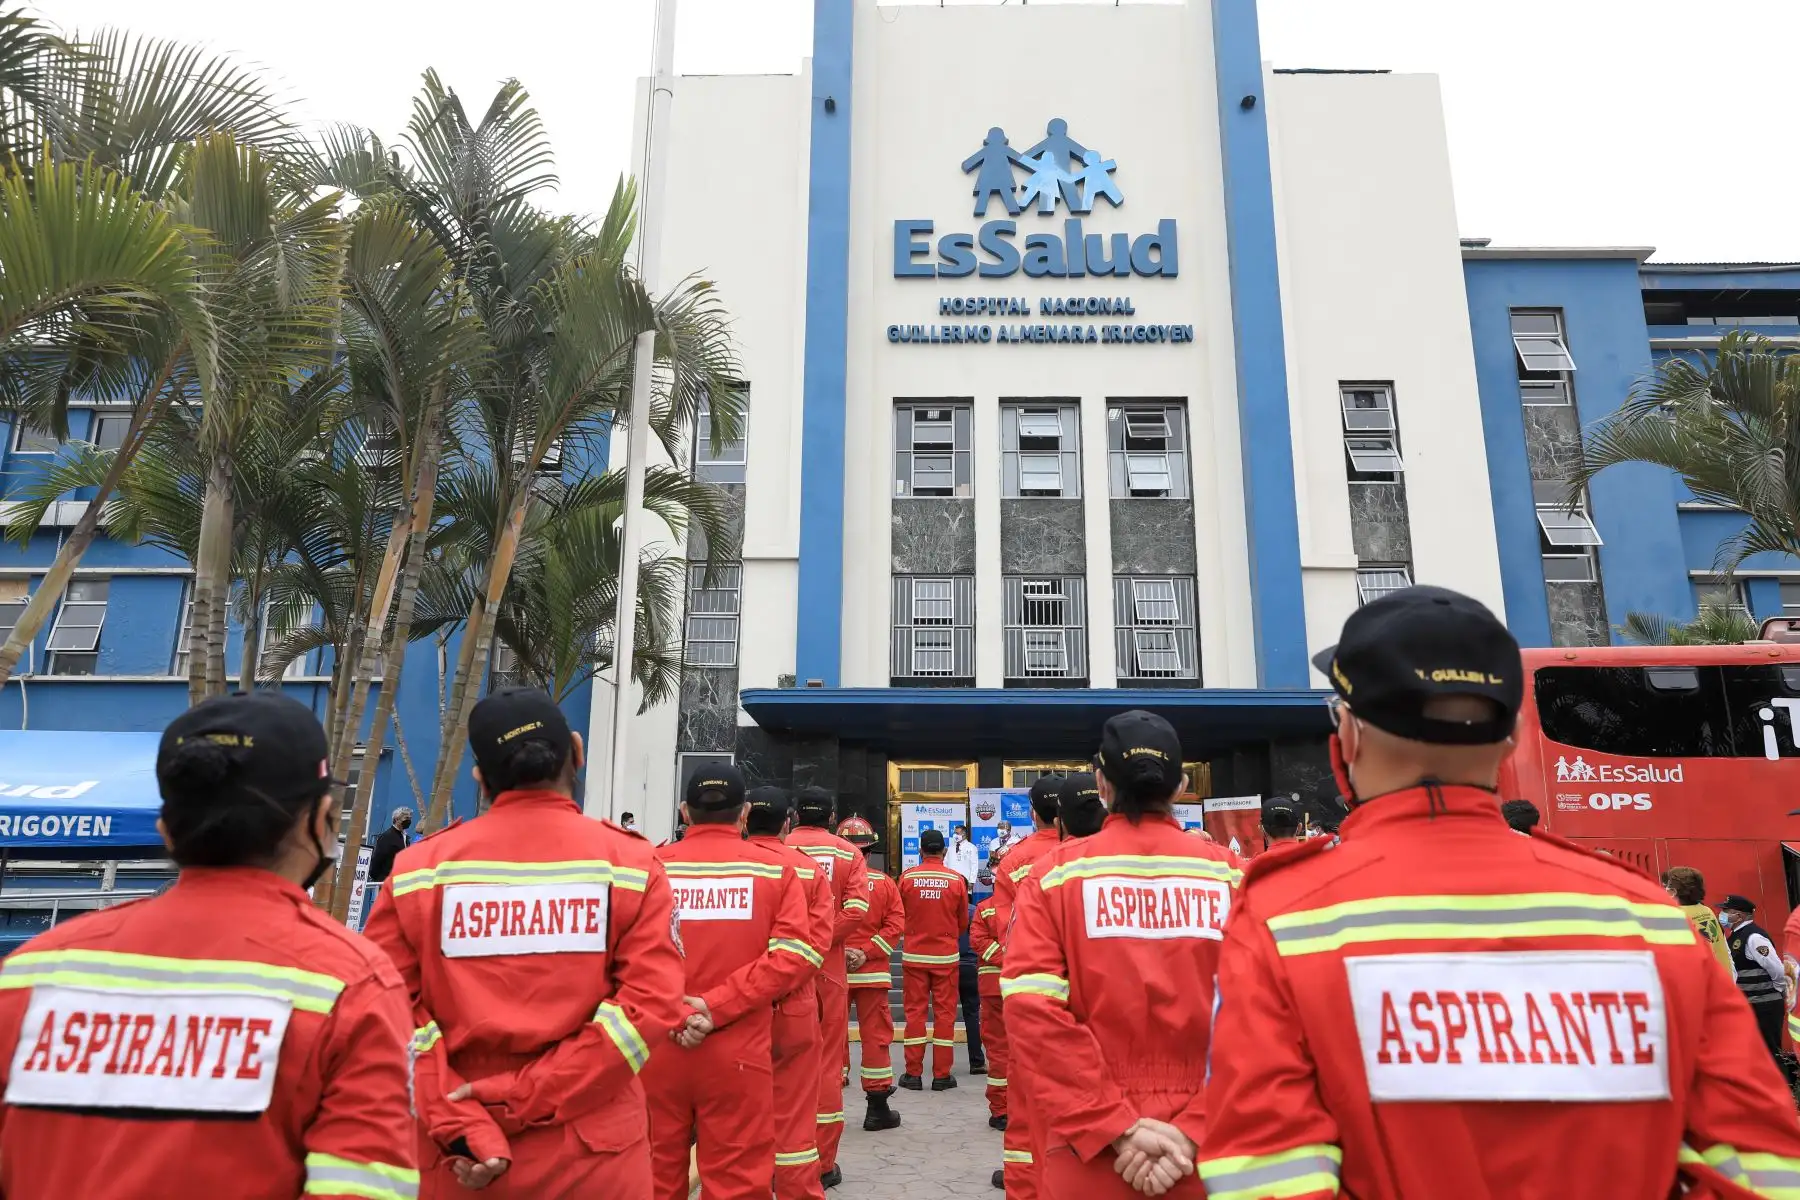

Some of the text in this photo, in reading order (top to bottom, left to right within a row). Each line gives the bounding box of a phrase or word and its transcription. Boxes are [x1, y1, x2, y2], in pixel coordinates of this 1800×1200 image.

[894, 219, 1178, 278] EsSalud
[939, 297, 1135, 315] HOSPITAL NACIONAL
[887, 325, 1194, 343] GUILLERMO ALMENARA IRIGOYEN
[1600, 764, 1683, 783] EsSalud
[1589, 793, 1653, 811] OPS
[913, 878, 949, 889] BOMBERO
[672, 887, 749, 909] SPIRANTE
[1096, 886, 1221, 929] ASPIRANTE
[448, 898, 600, 938] ASPIRANTE
[1377, 991, 1655, 1066] ASPIRANTE
[23, 1010, 272, 1079] ASPIRANTE
